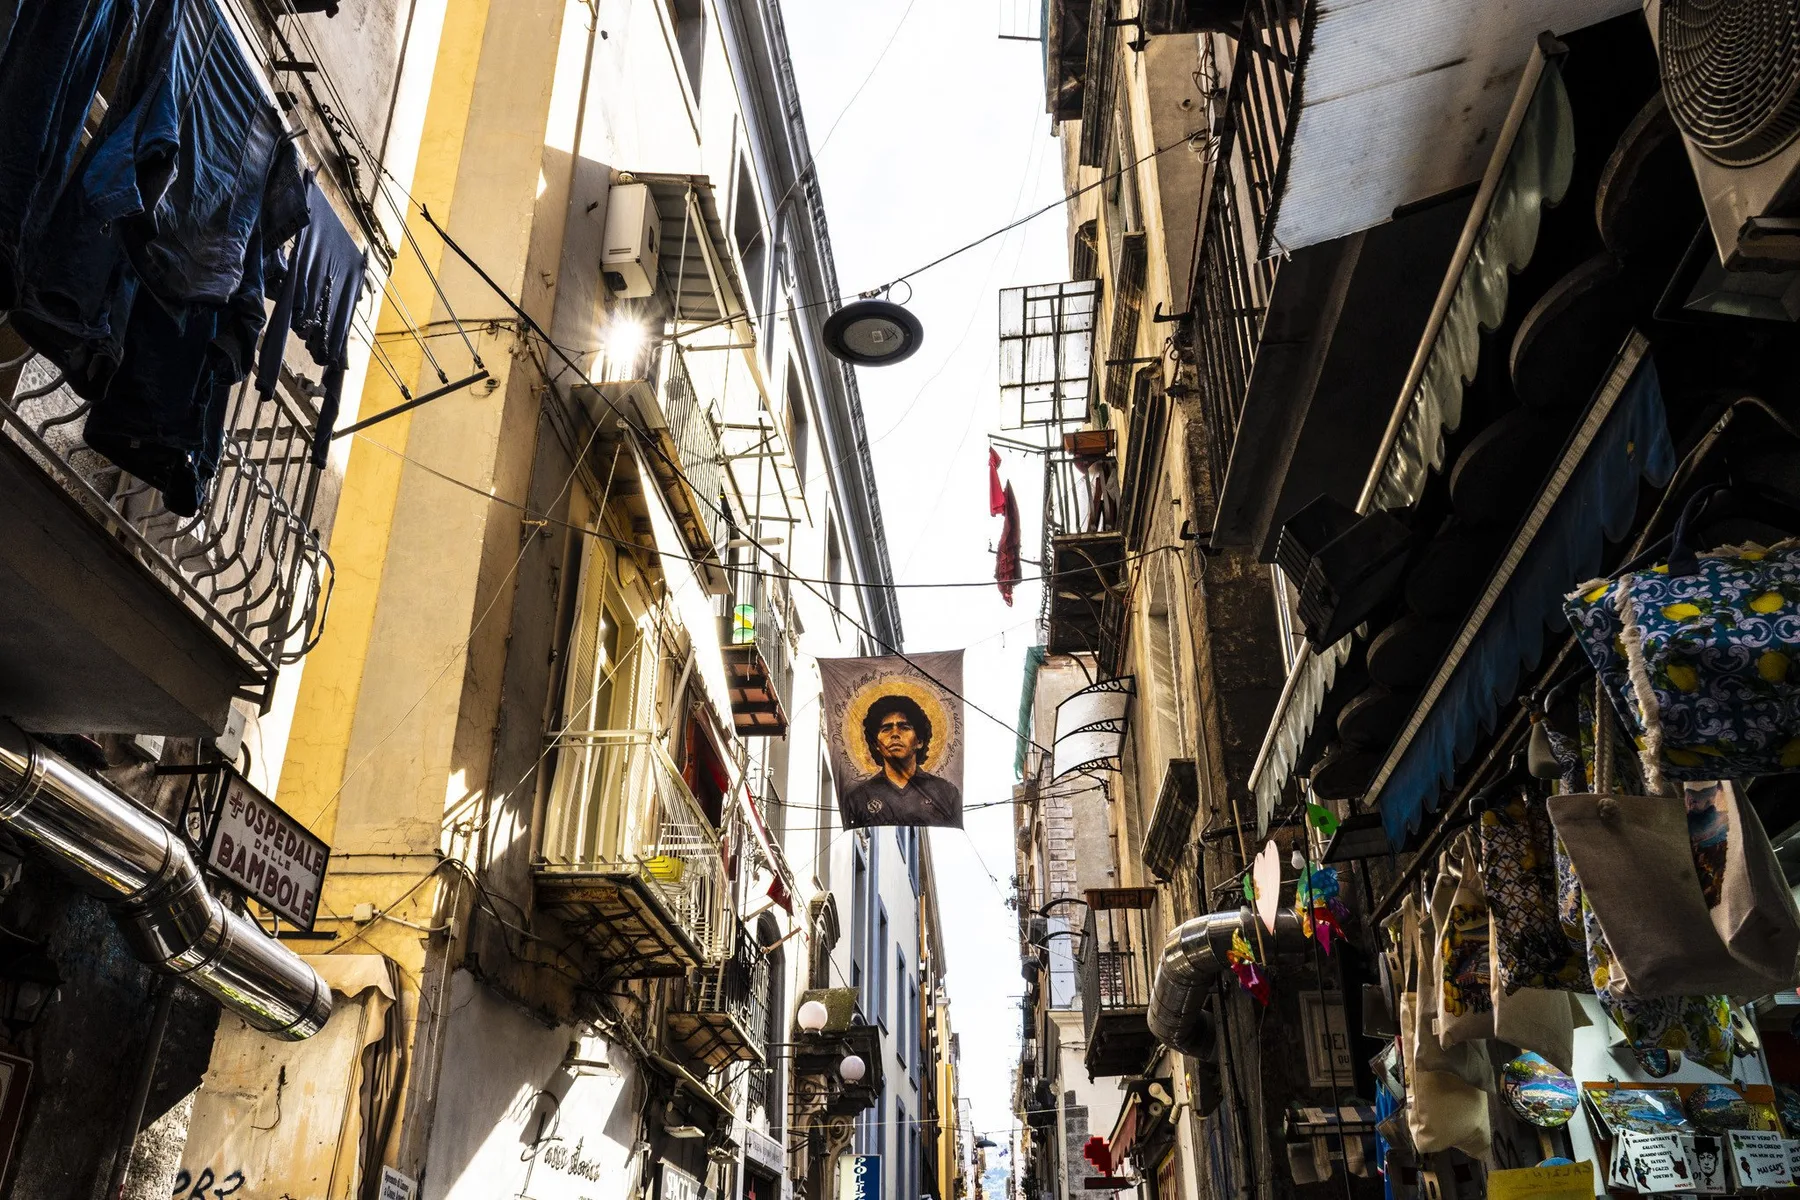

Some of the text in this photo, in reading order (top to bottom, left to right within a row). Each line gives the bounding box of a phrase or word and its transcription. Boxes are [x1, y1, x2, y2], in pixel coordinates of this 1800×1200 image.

[216, 831, 314, 923] BAMBOLE
[244, 801, 324, 878] OSPEDALE
[254, 838, 291, 871] DELLE
